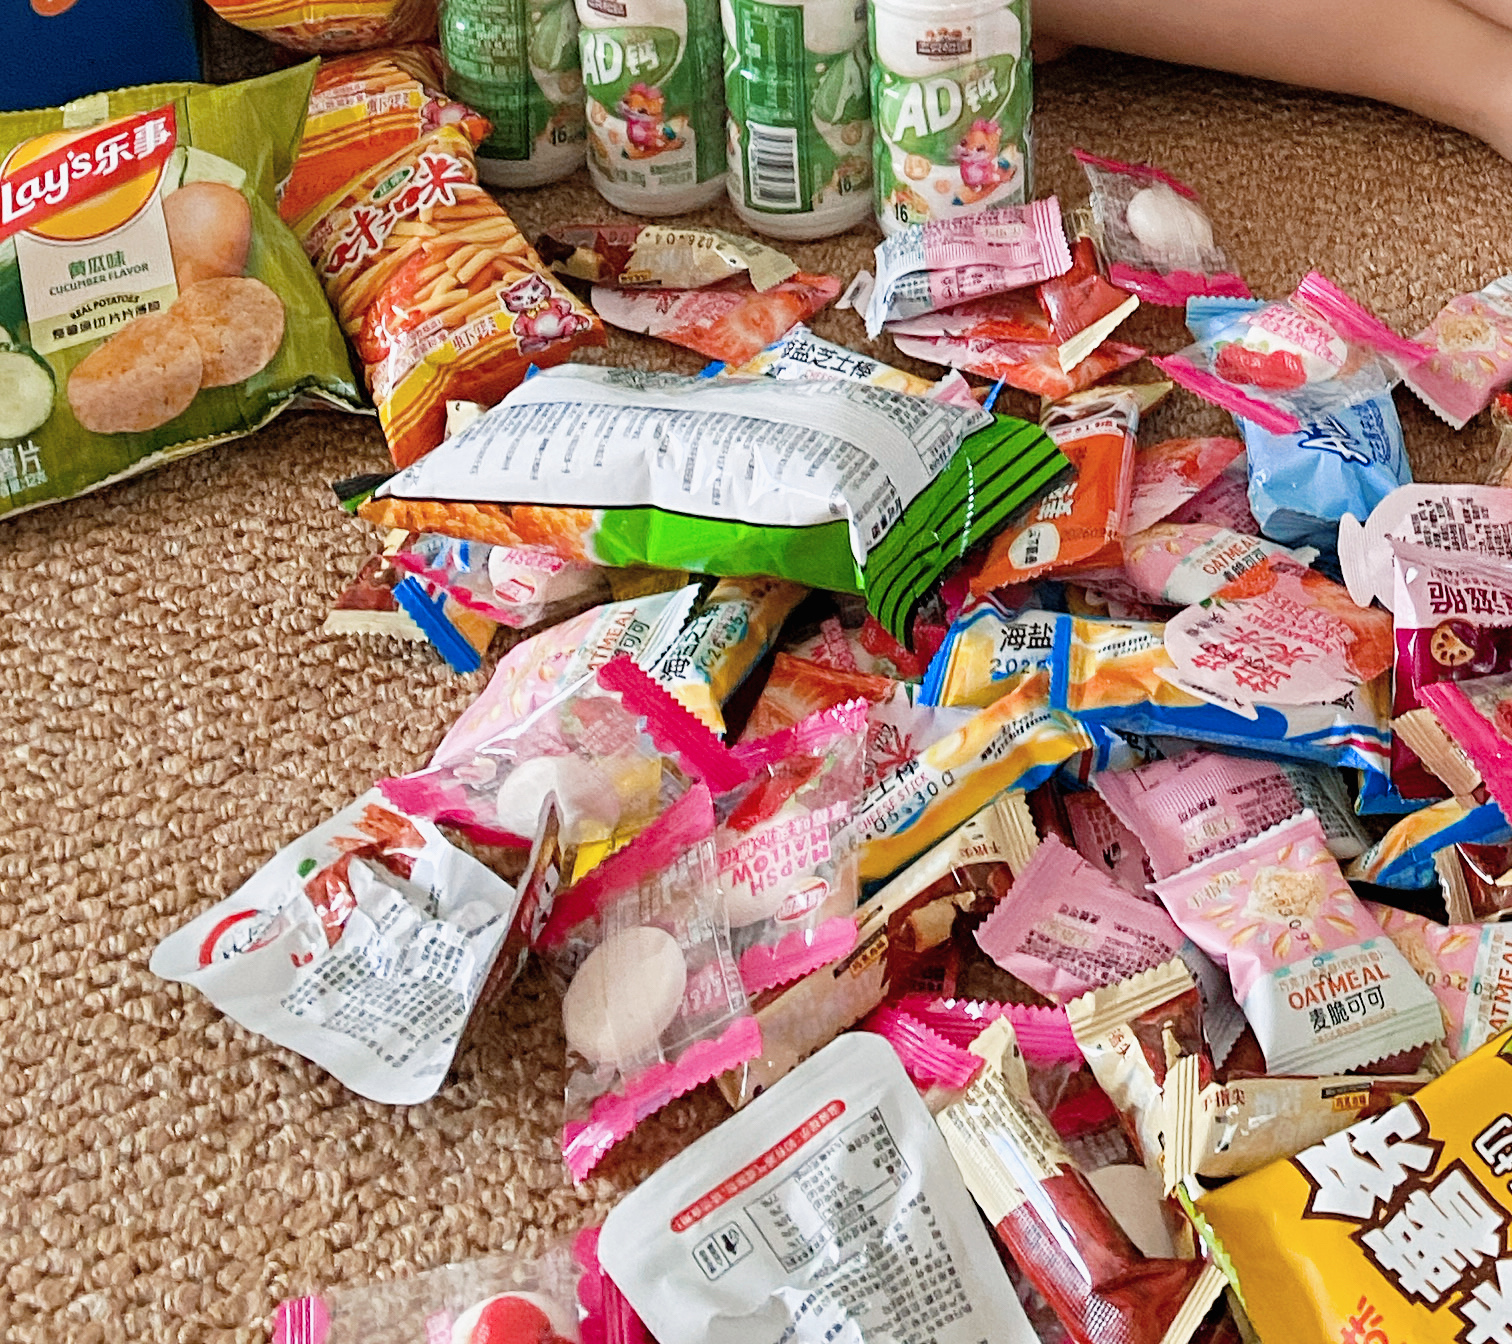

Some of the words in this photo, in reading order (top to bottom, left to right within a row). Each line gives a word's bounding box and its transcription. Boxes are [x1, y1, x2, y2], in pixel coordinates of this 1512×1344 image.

[0, 148, 93, 226] Lay's
[92, 115, 173, 175] 乐事
[49, 273, 108, 297] CUCUMBER
[107, 262, 150, 285] FLAVOR
[1287, 964, 1393, 1011] OATMEAL
[1308, 984, 1387, 1033] 麦脆可可
